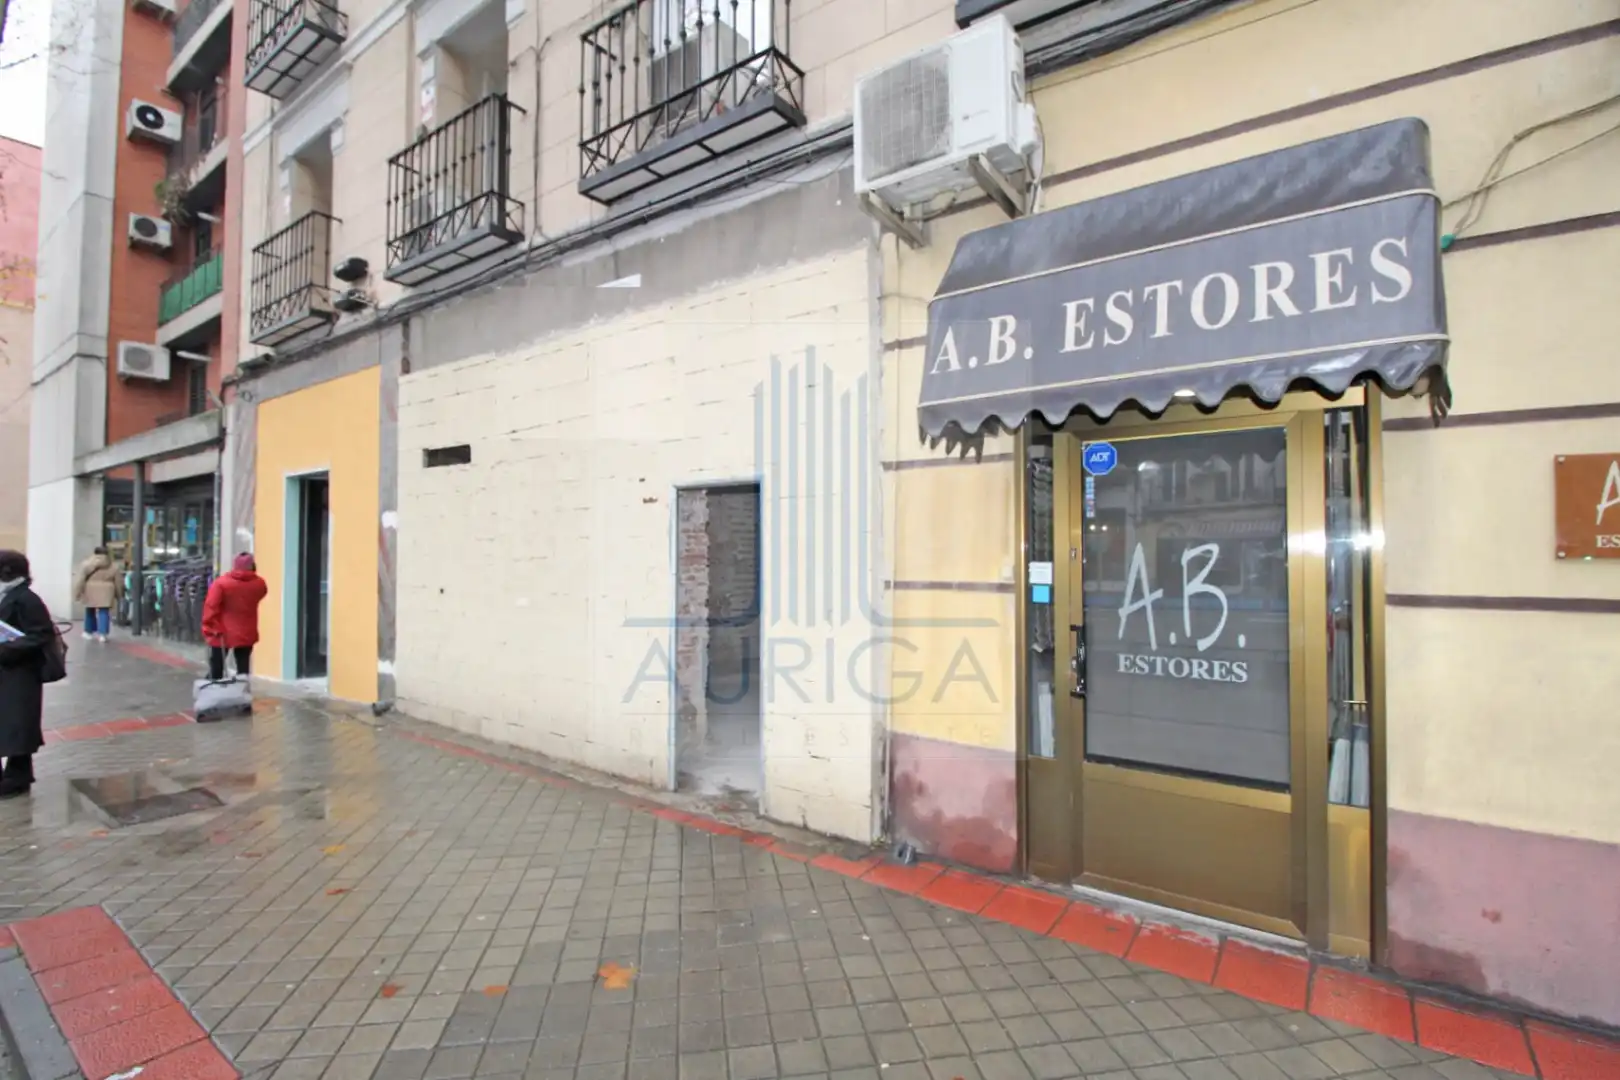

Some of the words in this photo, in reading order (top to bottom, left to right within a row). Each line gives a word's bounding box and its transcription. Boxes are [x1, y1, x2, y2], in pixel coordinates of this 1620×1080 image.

[931, 313, 1034, 375] A.B.
[1061, 238, 1413, 353] ESTORES
[1090, 451, 1110, 462] ADT
[1118, 542, 1246, 651] A.B.
[1117, 653, 1249, 683] ESTORES
